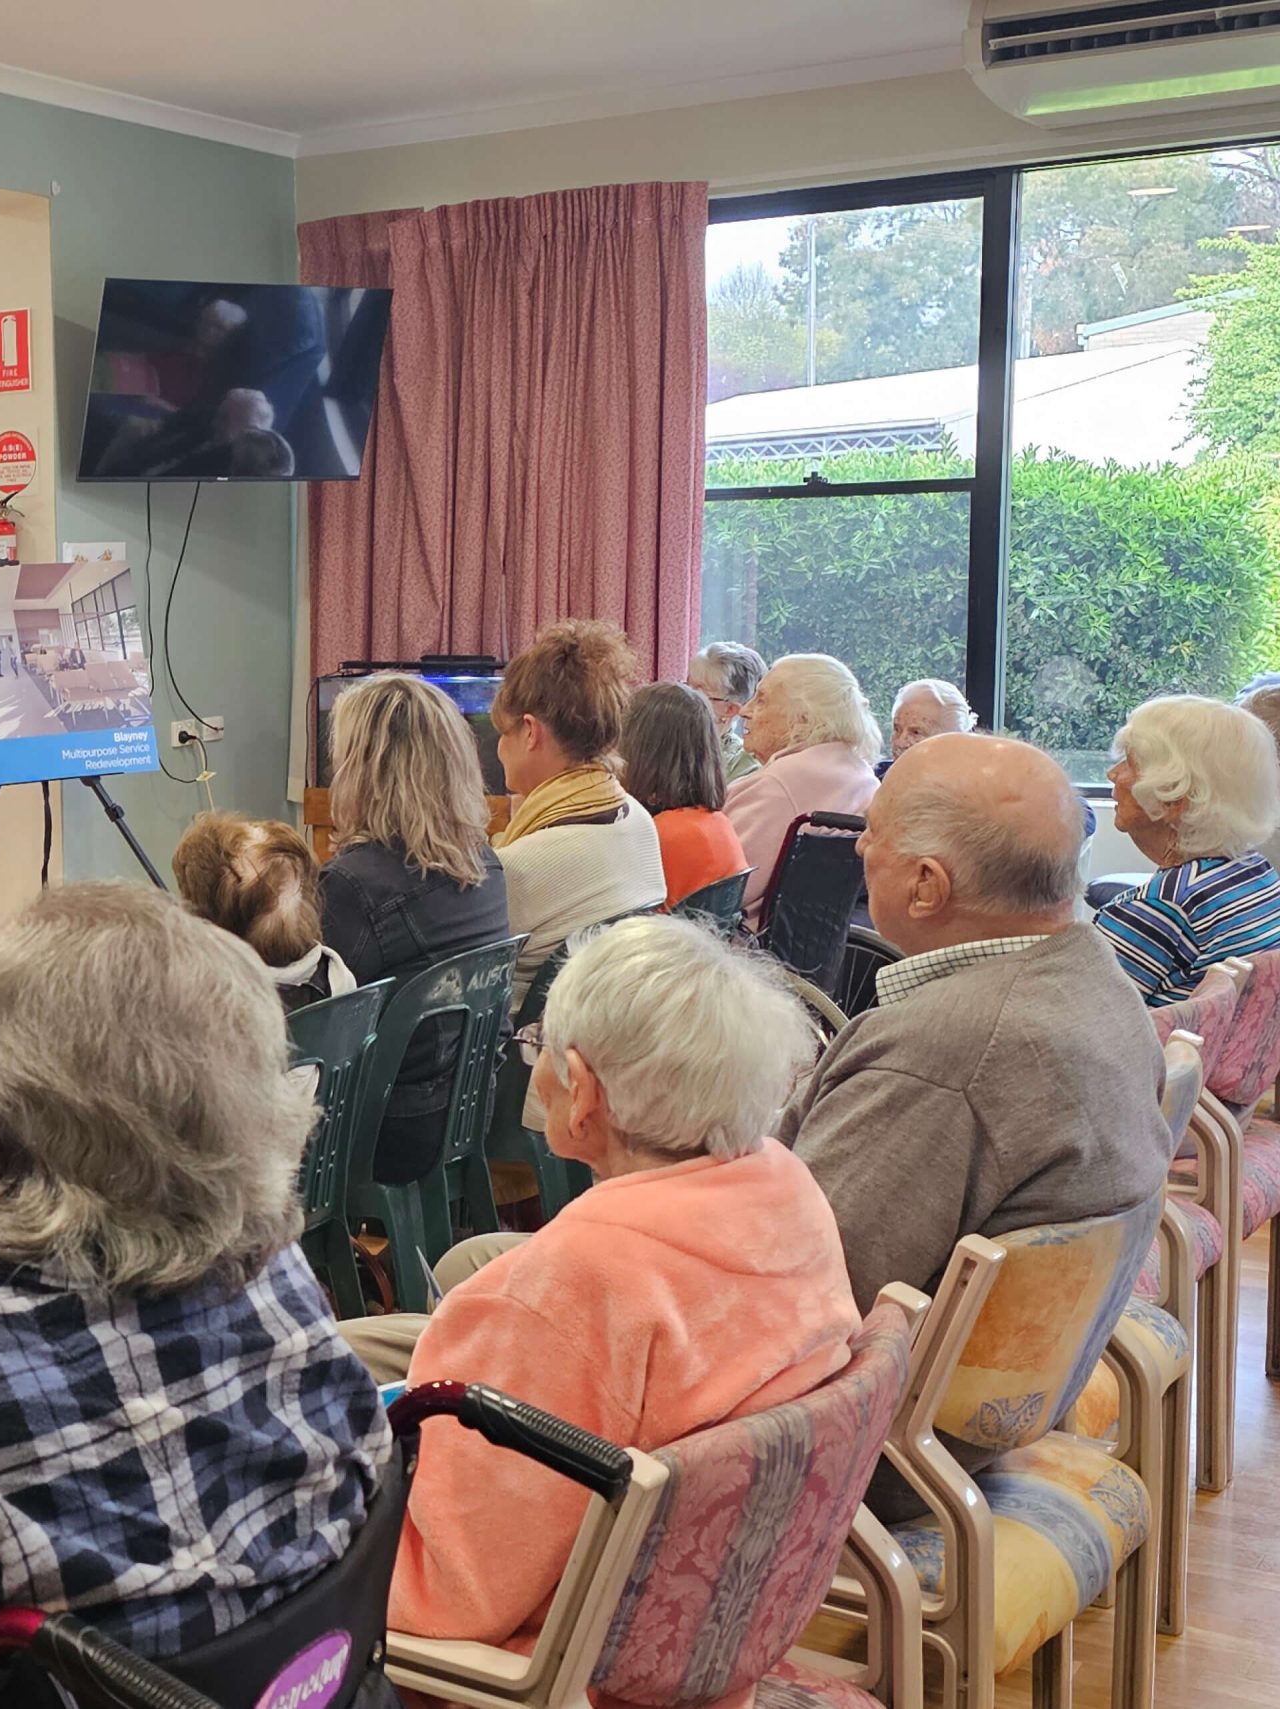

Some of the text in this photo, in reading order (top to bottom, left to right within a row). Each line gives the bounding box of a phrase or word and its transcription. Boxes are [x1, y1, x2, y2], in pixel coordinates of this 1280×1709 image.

[2, 368, 18, 377] FIRE
[114, 731, 148, 743] Blayney
[62, 744, 150, 760] Multipurpose Service
[85, 755, 151, 769] Redevelopment
